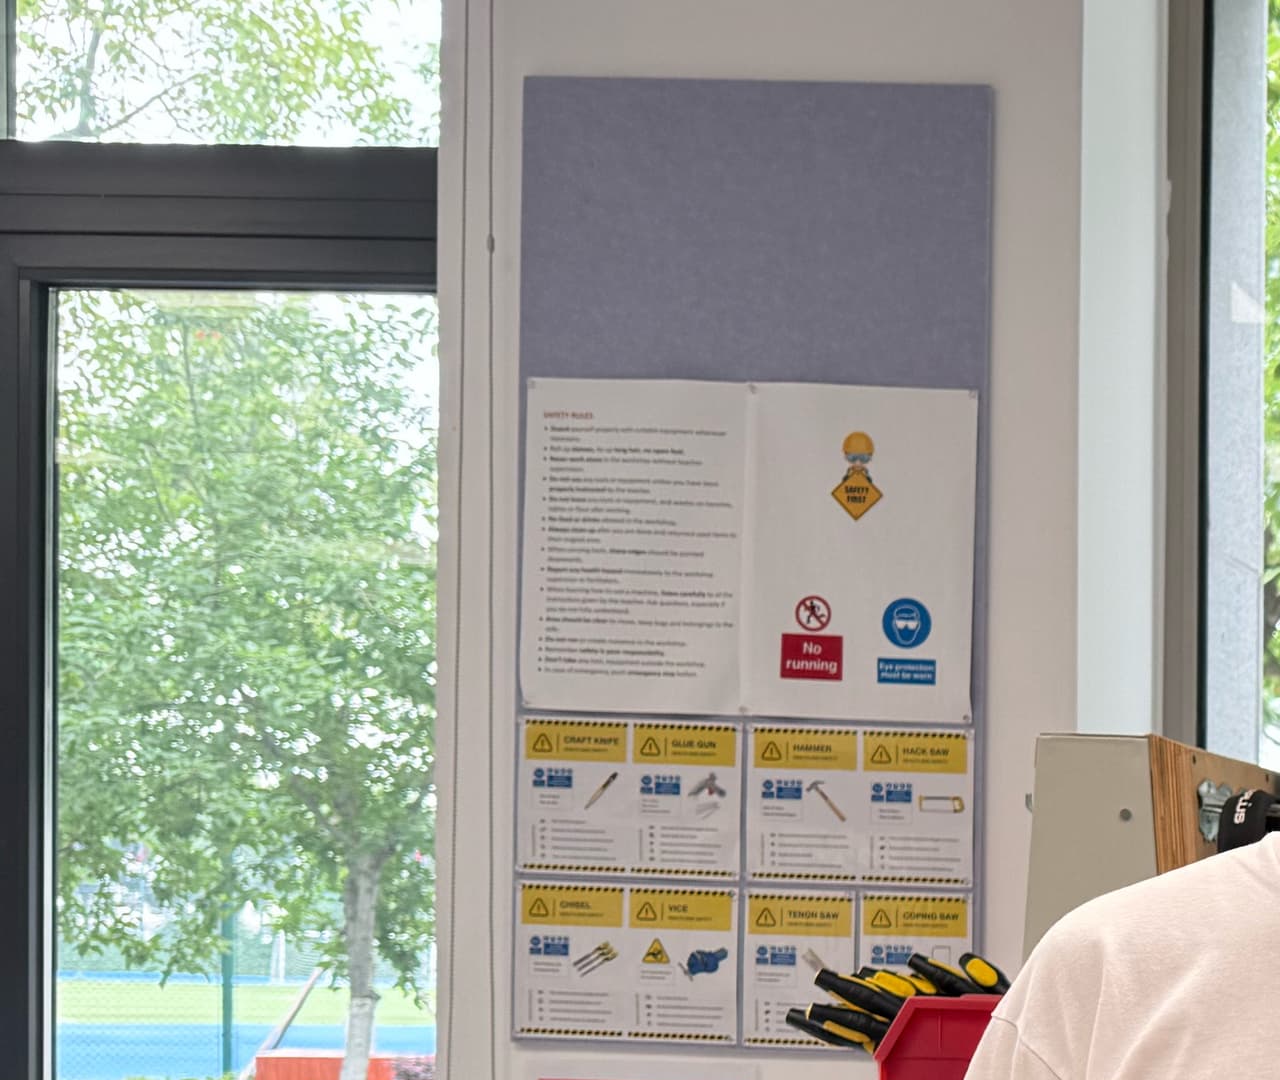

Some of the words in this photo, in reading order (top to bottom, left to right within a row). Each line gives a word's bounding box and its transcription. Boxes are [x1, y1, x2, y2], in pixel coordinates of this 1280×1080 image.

[802, 641, 822, 655] No
[786, 658, 838, 675] running
[792, 744, 832, 753] HAMMER
[668, 904, 688, 913] VICE
